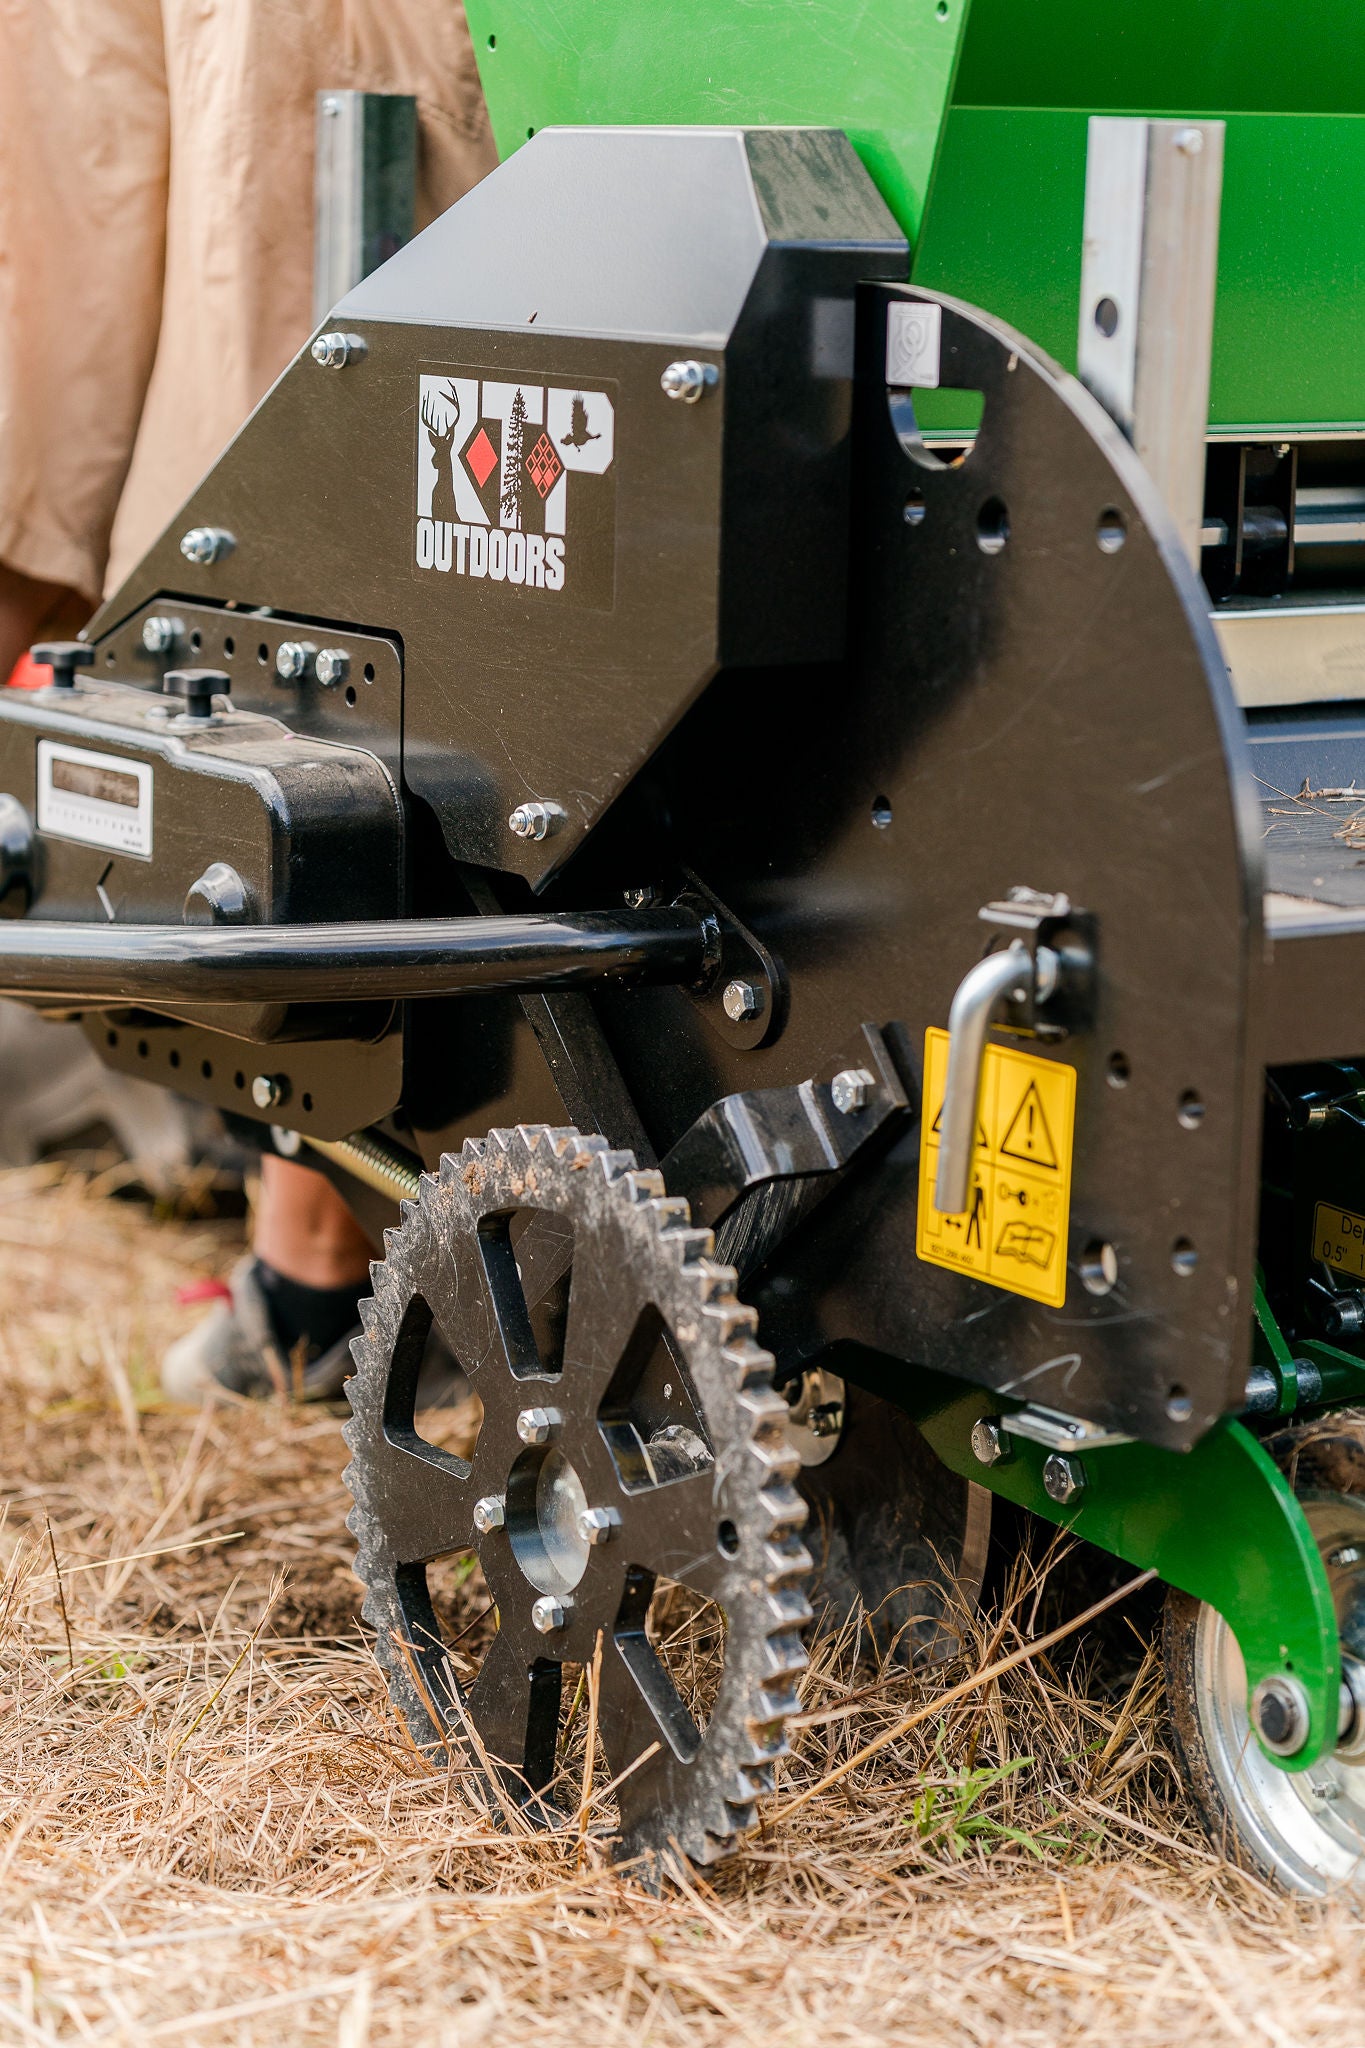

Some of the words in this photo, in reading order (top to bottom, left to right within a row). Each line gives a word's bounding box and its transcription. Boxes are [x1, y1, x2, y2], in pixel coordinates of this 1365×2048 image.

[417, 374, 615, 536] RTP
[416, 517, 566, 591] OUTDOORS
[1323, 1240, 1348, 1262] 0.5"
